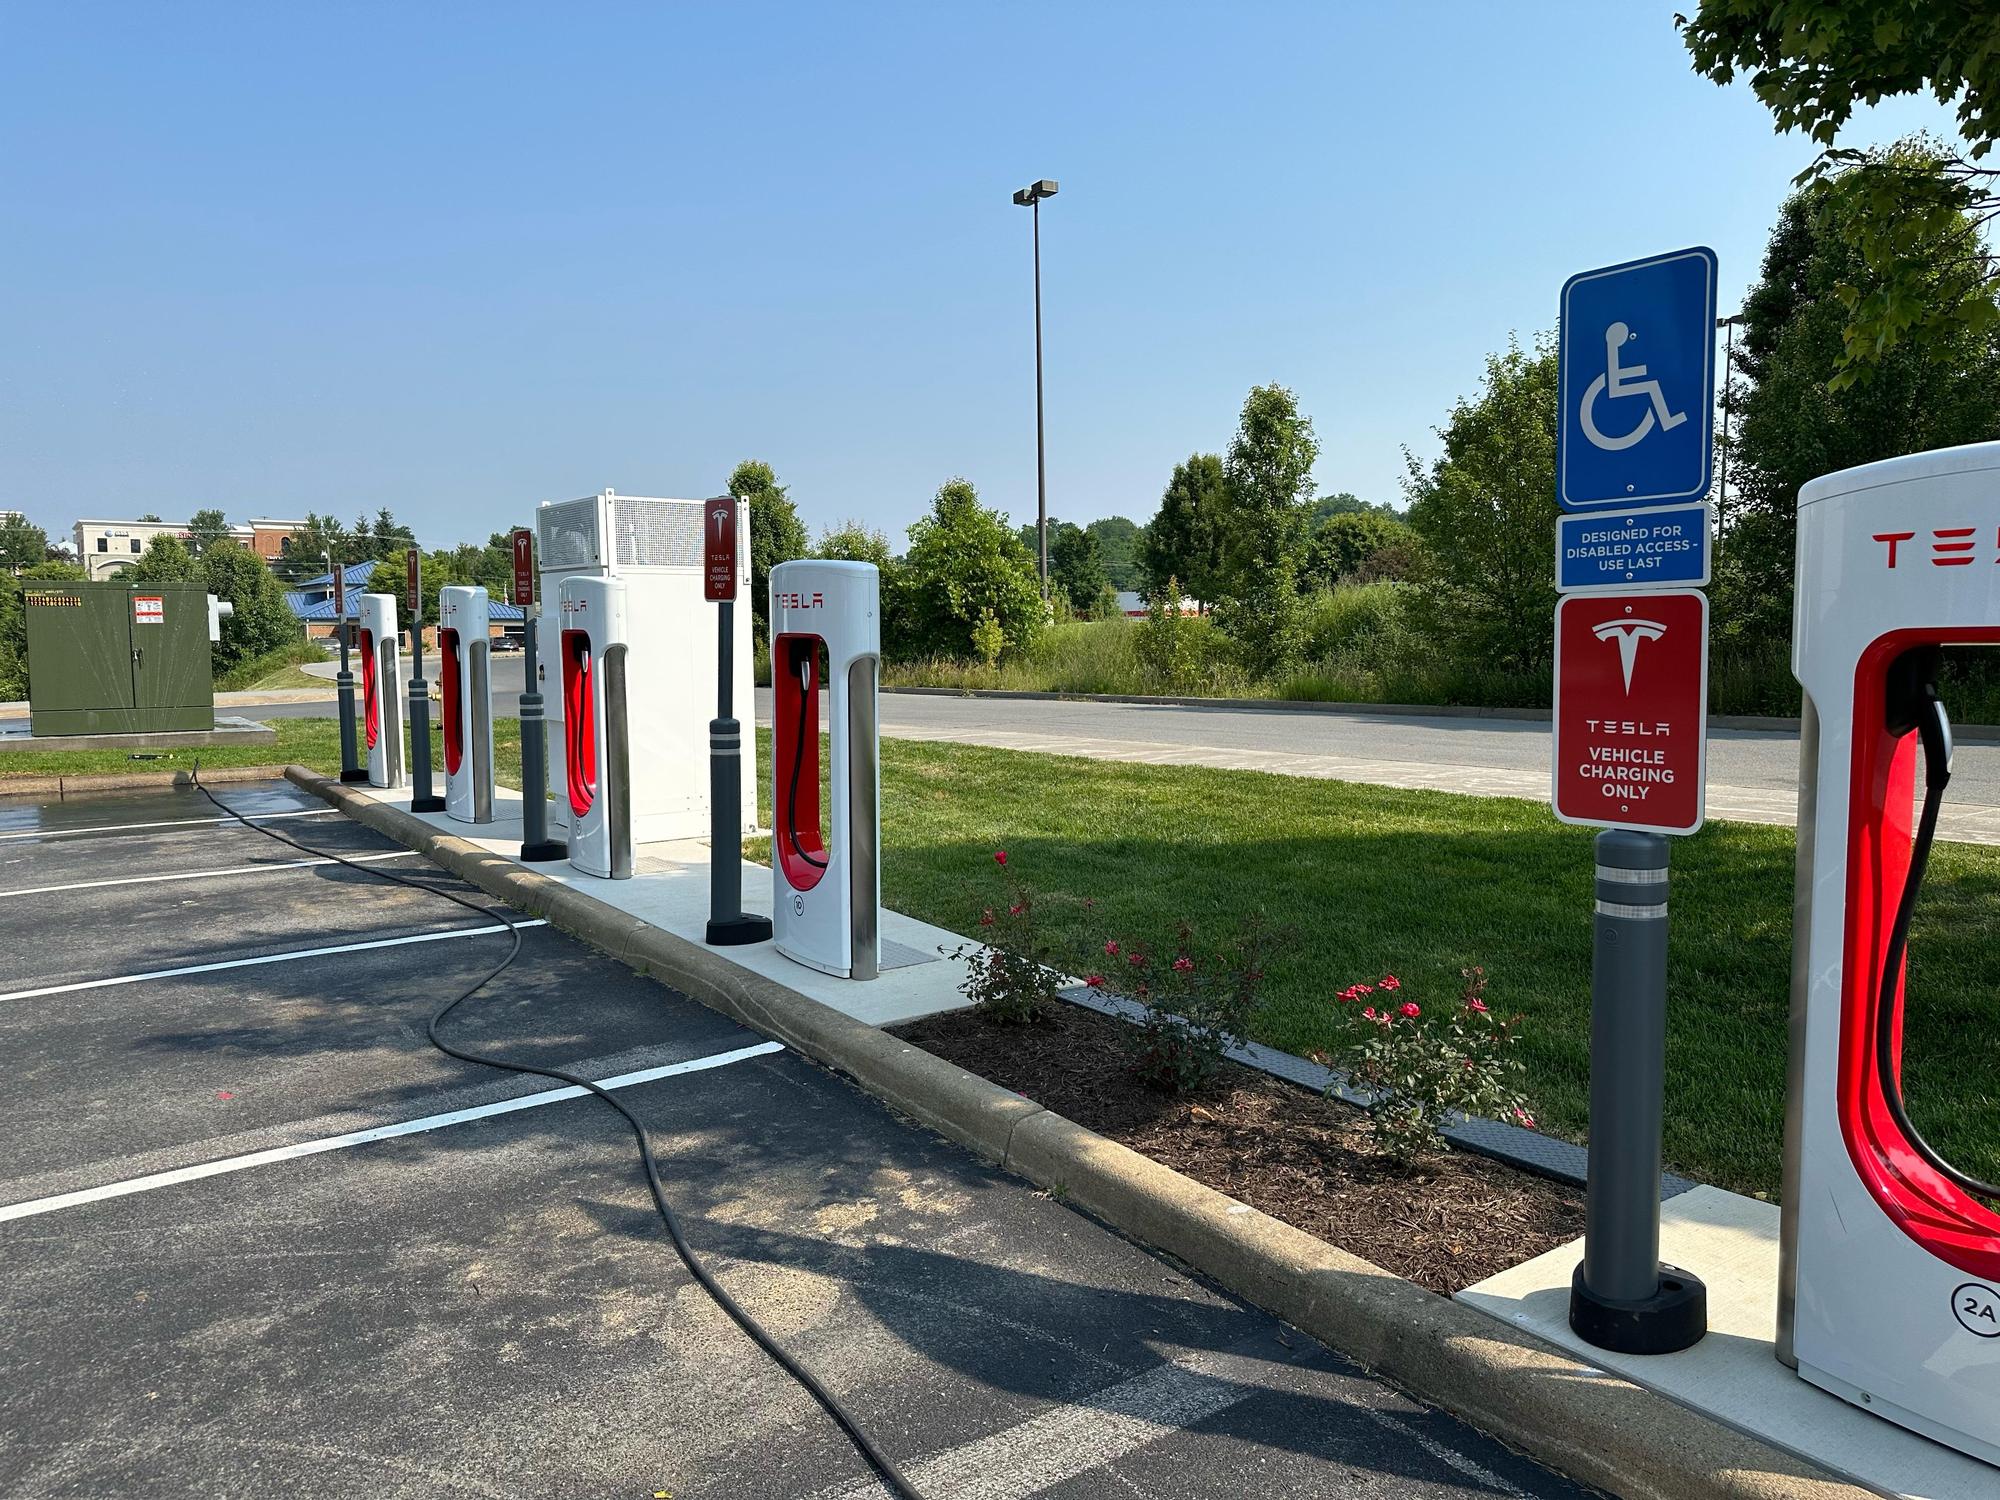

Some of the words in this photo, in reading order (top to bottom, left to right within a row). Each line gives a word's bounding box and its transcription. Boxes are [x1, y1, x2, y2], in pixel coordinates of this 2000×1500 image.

[1581, 528, 1649, 543] DESIGNED
[1653, 525, 1682, 538] FOR
[1567, 544, 1631, 559] DISABLED
[1635, 540, 1690, 554] ACCESS
[1872, 527, 2000, 569] TE
[1599, 560, 1624, 570] USE
[1628, 556, 1662, 569] LAST
[775, 593, 823, 609] TESLA
[1586, 719, 1670, 736] TESLA
[1589, 746, 1665, 765] VEHICLE
[1579, 763, 1675, 783] CHARGING
[1601, 783, 1650, 800] ONLY
[1963, 1297, 1997, 1323] 2A
